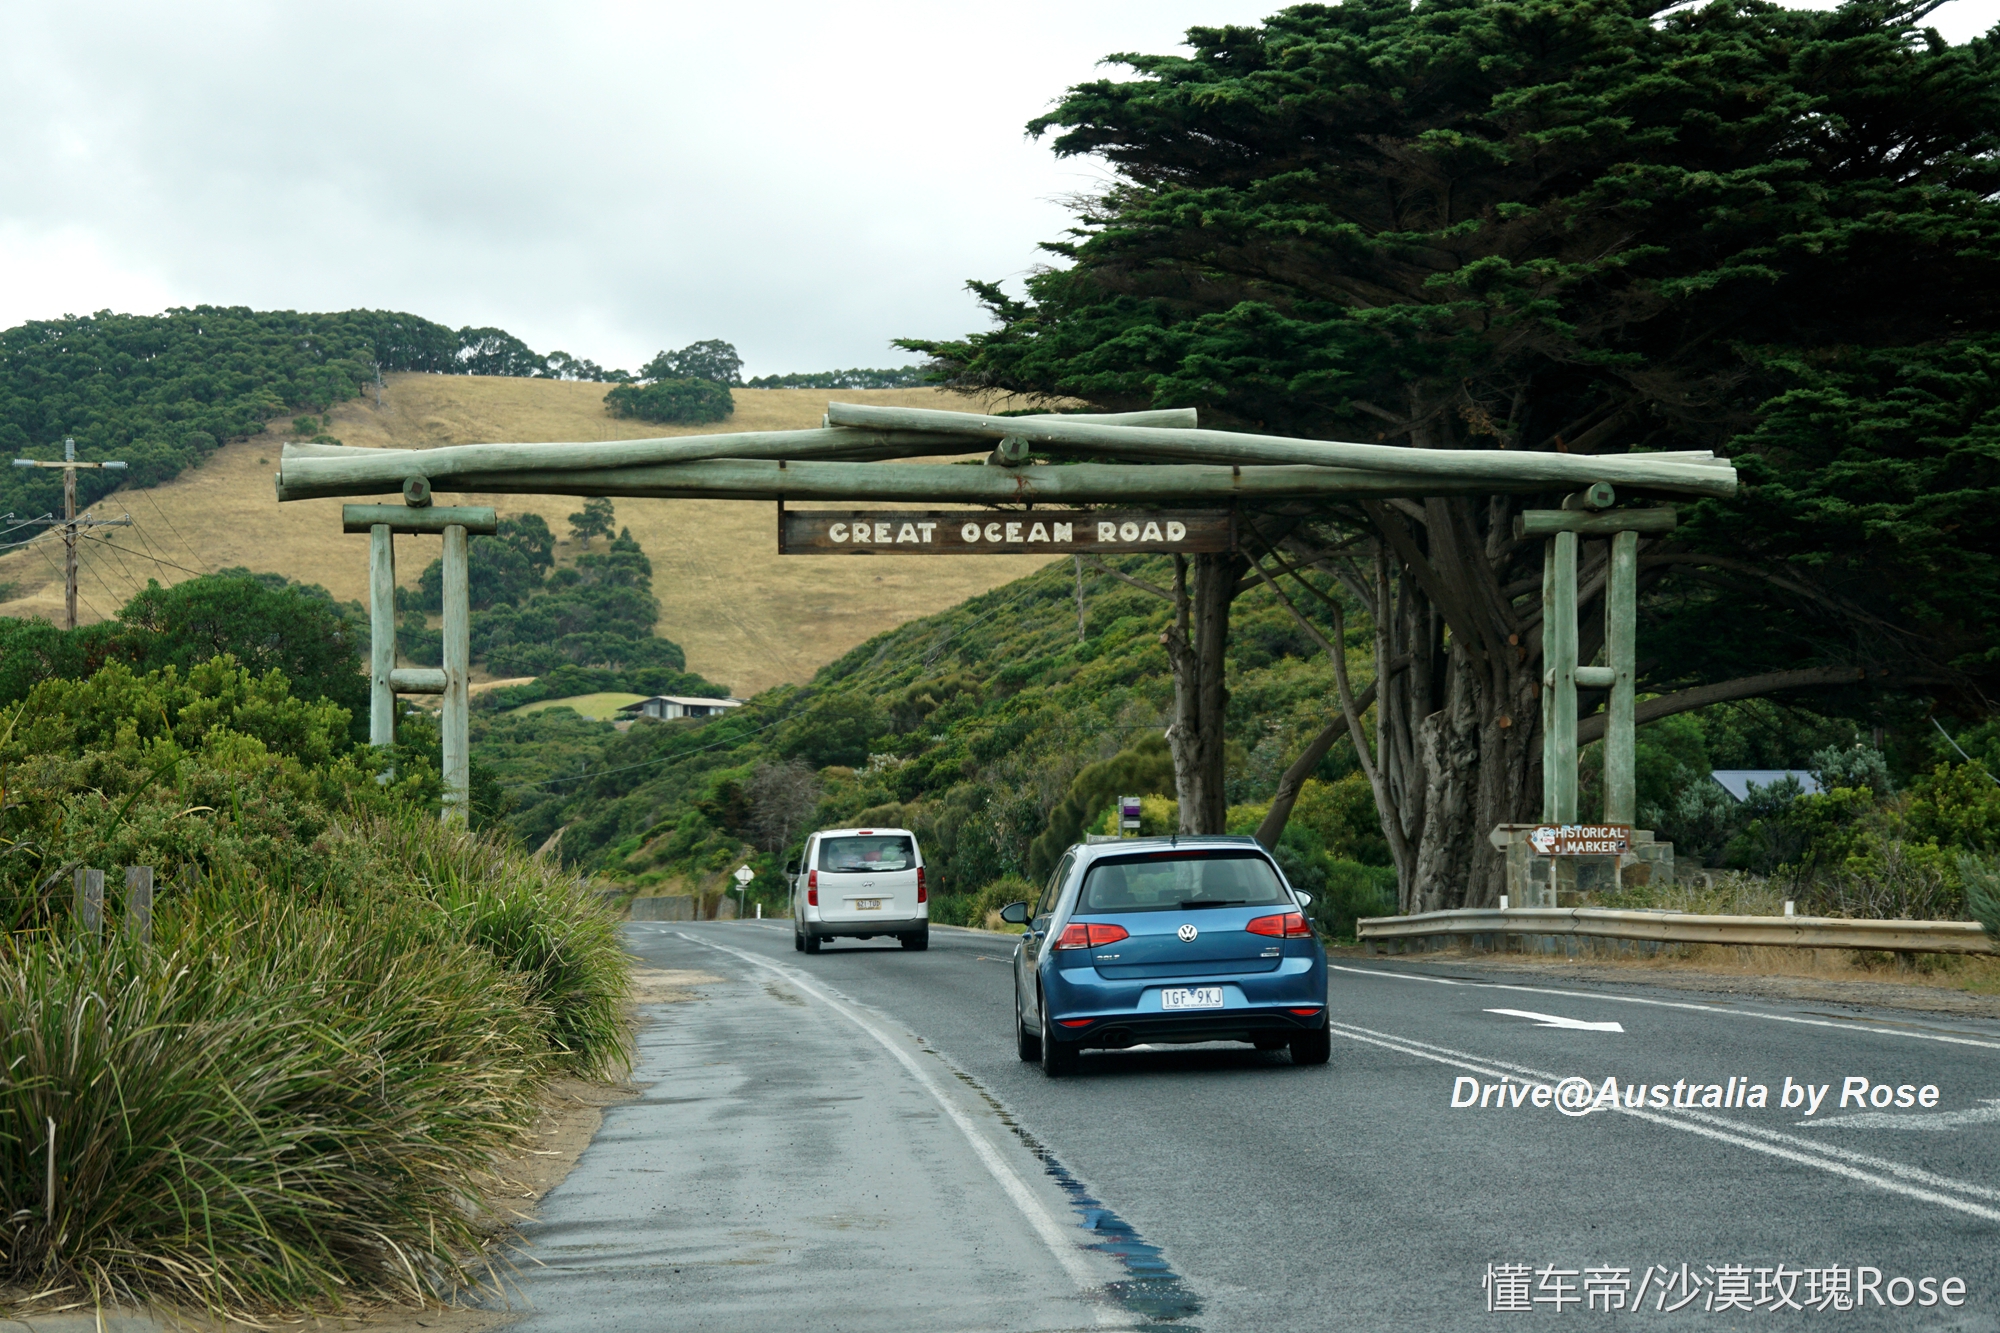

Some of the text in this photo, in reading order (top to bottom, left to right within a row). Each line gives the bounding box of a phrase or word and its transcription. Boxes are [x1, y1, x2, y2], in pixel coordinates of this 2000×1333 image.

[828, 520, 1187, 543] GREAT OCEAN ROAD
[1555, 826, 1625, 839] HISTORICAL
[1566, 840, 1617, 852] MARKER
[1165, 990, 1222, 1005] 1GF 9KJ
